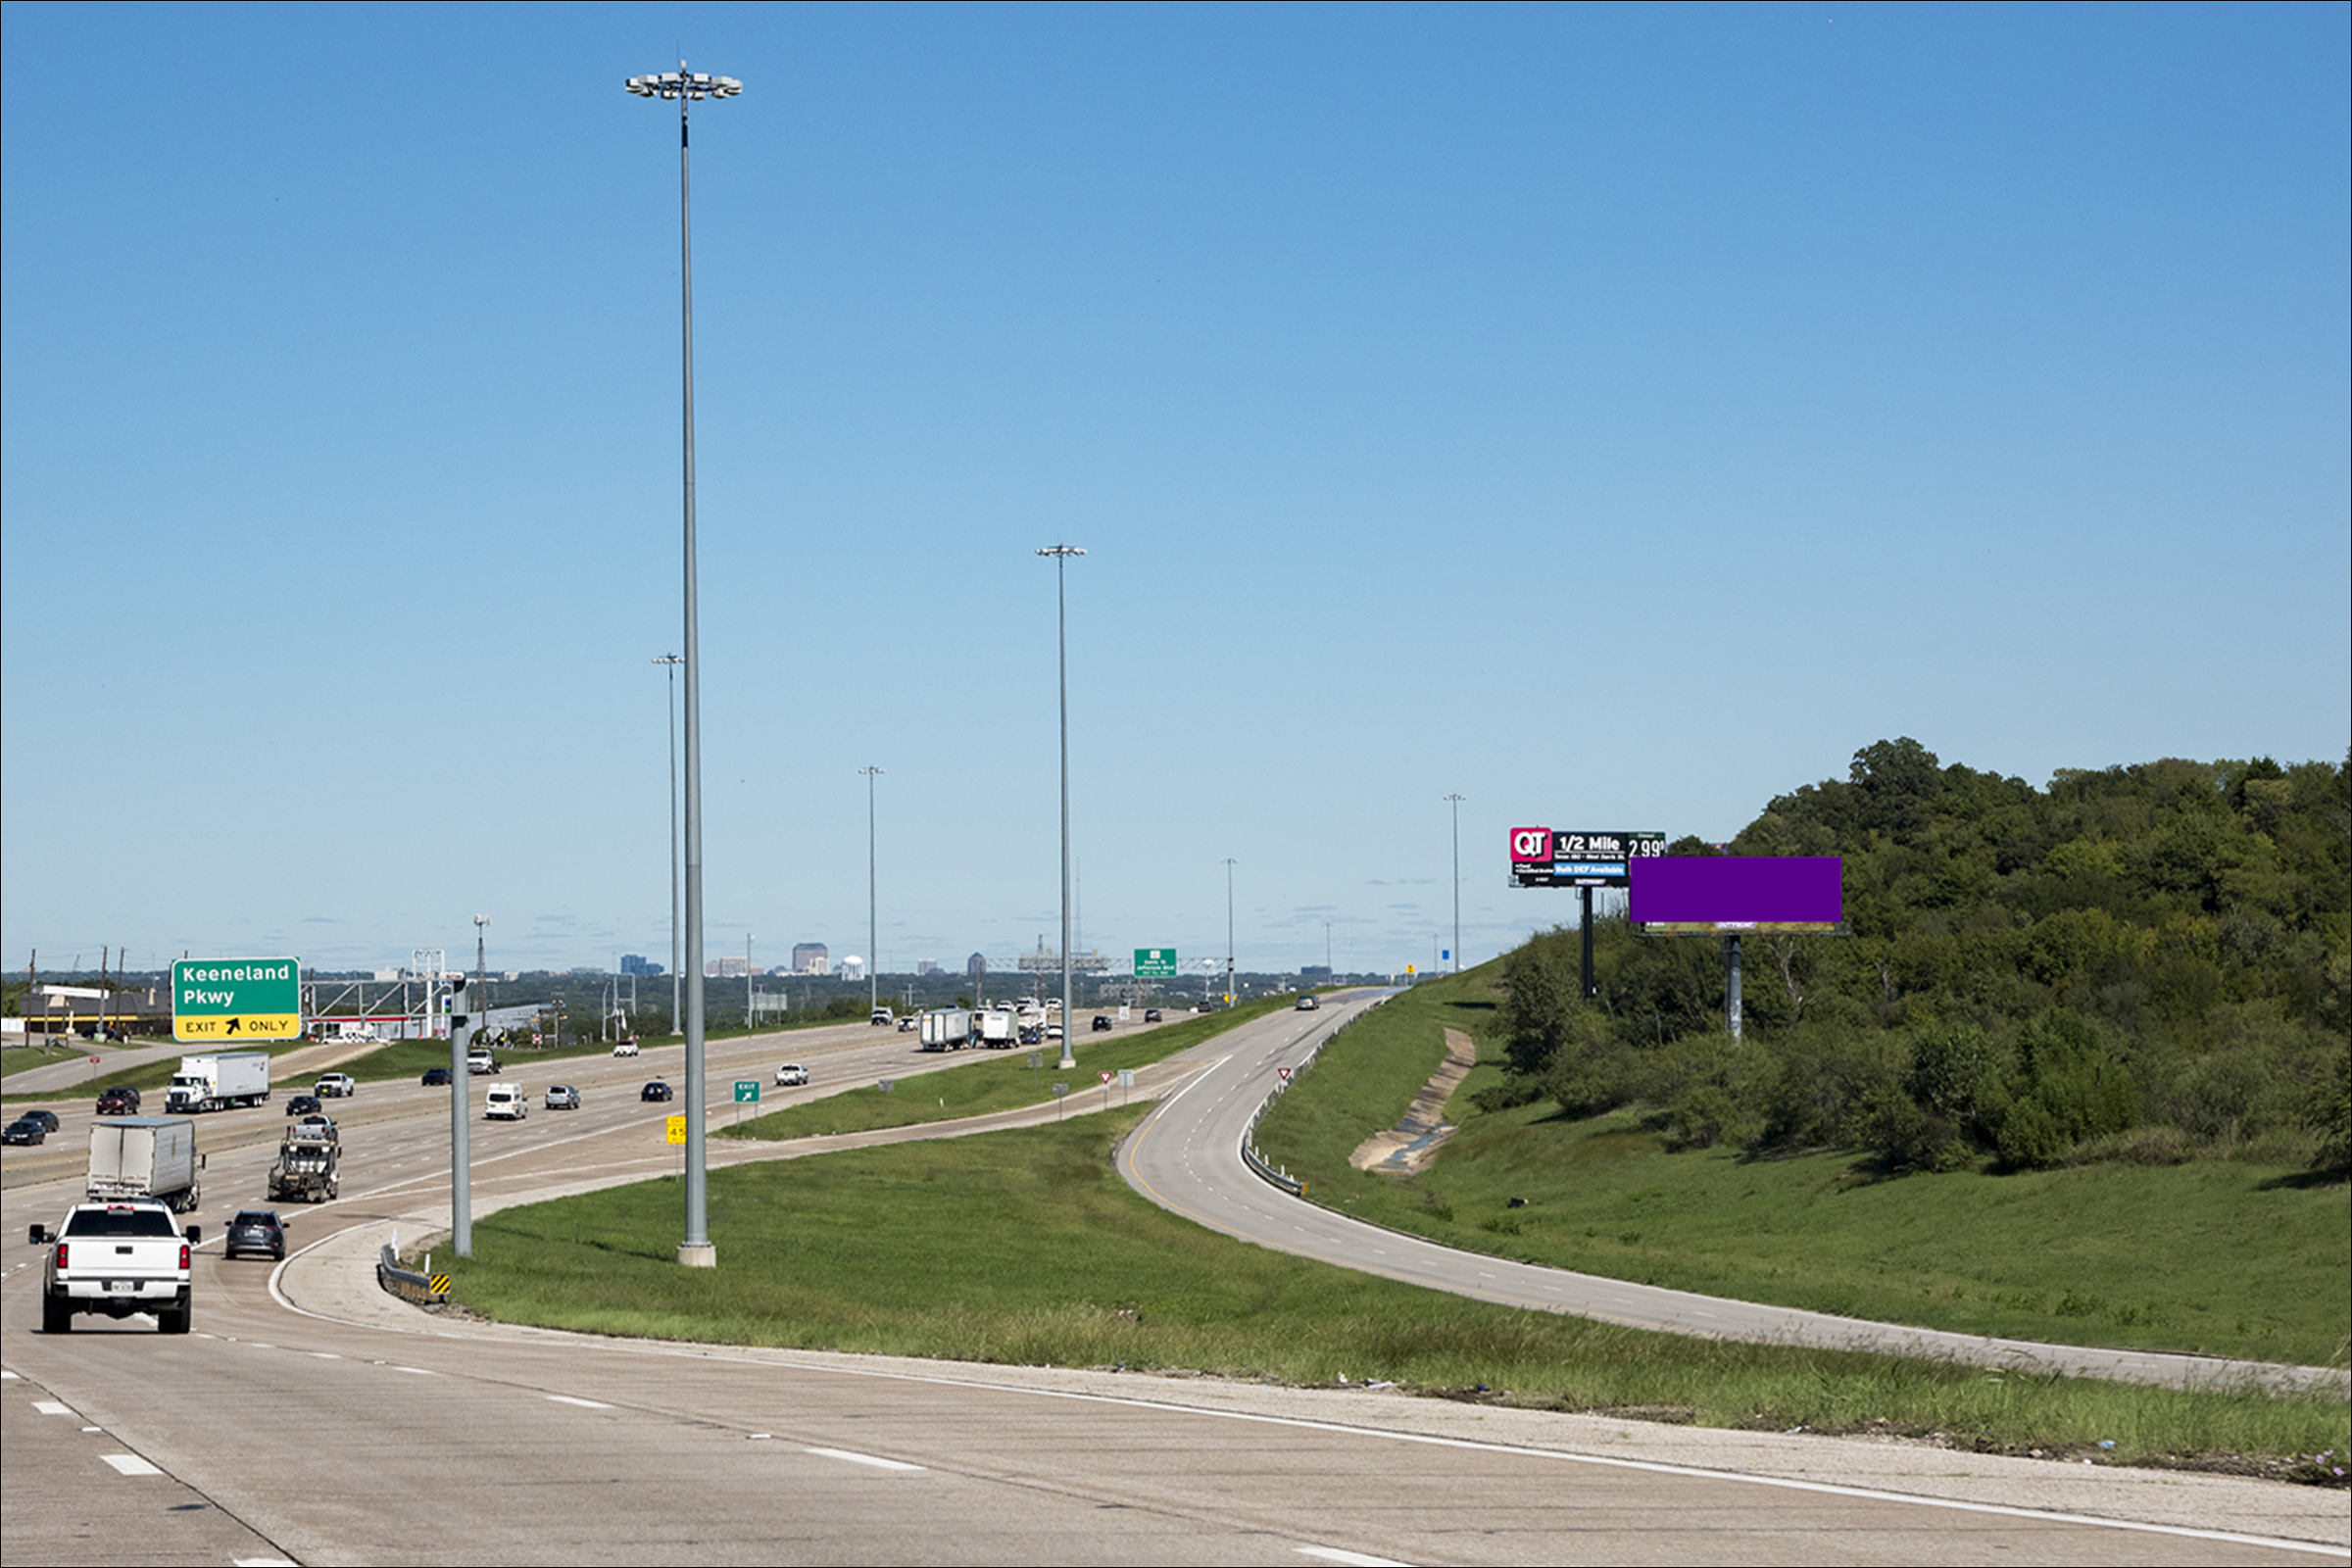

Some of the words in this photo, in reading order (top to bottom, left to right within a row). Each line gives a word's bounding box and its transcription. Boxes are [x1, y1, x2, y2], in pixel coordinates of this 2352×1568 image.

[1514, 831, 1545, 857] QT
[1559, 835, 1585, 852] 1/2
[1589, 836, 1620, 851] Mile
[1591, 864, 1624, 874] Available
[183, 964, 289, 982] Keeneland
[183, 989, 234, 1007] Pkwy
[185, 1022, 217, 1033] EXIT
[249, 1020, 289, 1032] ONLY
